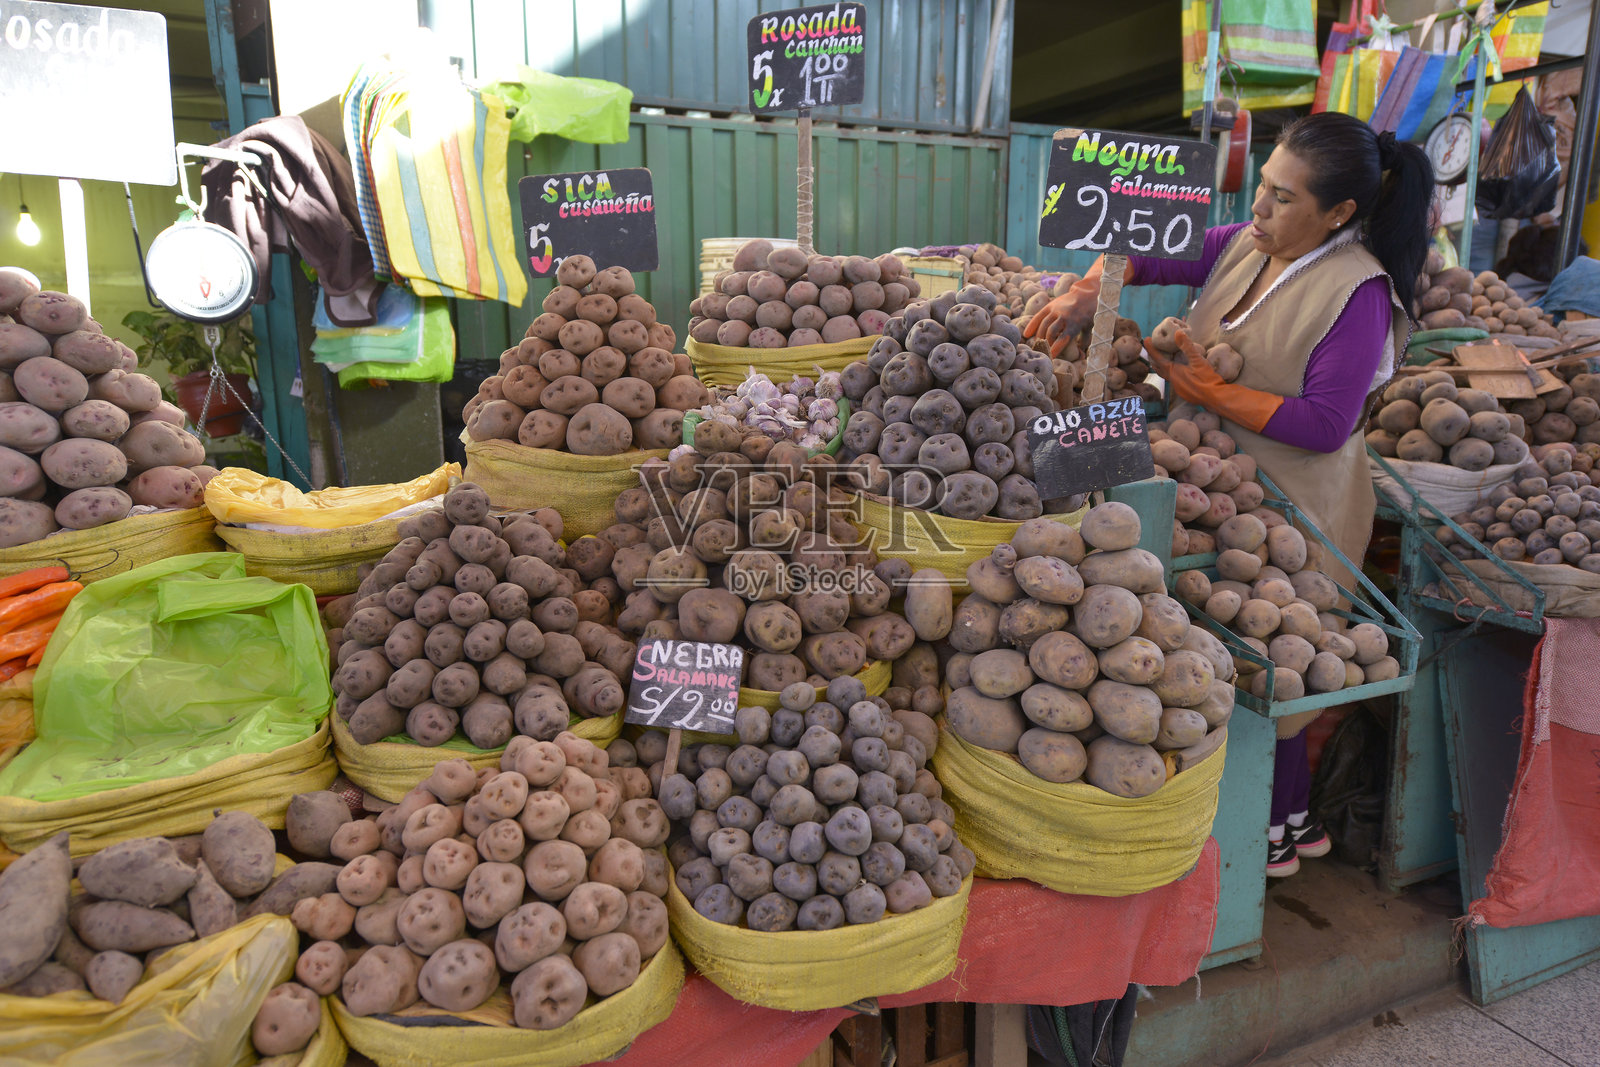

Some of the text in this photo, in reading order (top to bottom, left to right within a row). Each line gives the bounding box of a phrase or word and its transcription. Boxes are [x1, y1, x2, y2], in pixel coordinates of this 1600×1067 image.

[0, 8, 137, 55] osada
[761, 2, 862, 44] Rosada
[784, 34, 864, 59] canchan
[1072, 132, 1185, 177] Negra
[540, 172, 616, 203] SICA
[1109, 174, 1212, 205] Salamanca
[1033, 397, 1146, 435] OJO AZUL
[1058, 416, 1144, 448] CAÑETE
[651, 640, 743, 669] NEGRA
